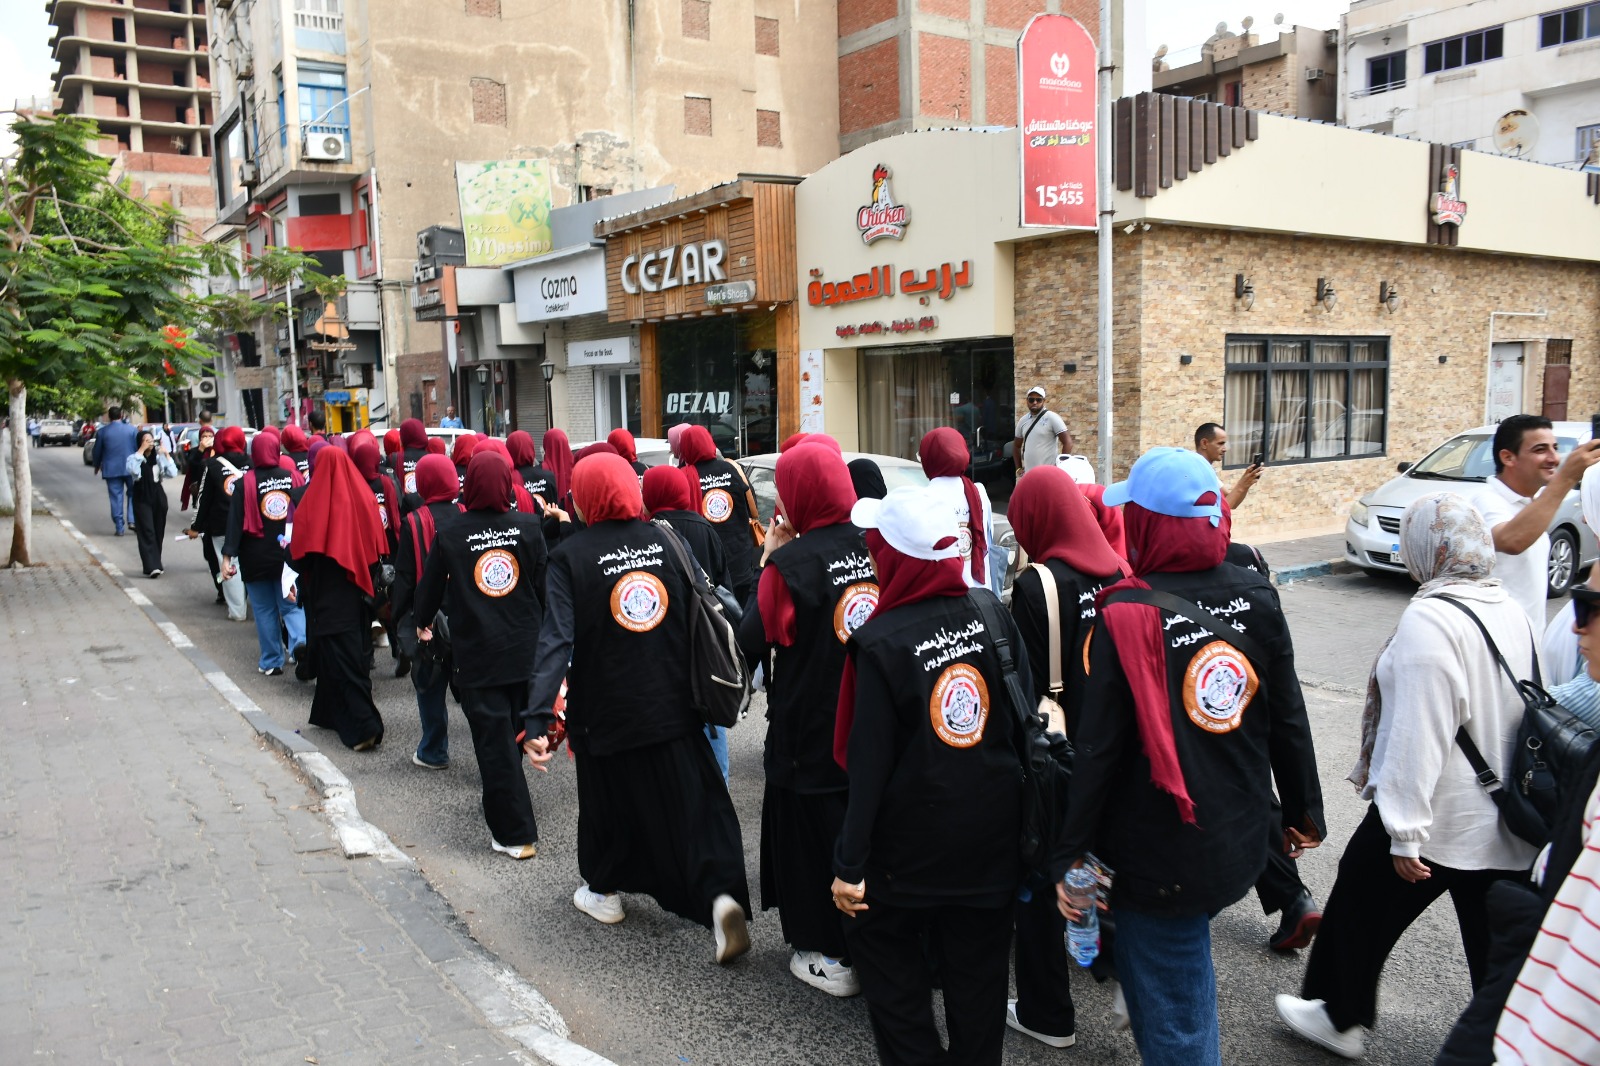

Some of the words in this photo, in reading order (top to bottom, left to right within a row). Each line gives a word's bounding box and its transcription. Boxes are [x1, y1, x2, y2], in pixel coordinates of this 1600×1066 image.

[1036, 185, 1084, 207] 15455
[859, 204, 905, 228] Chicken
[469, 222, 511, 235] Pizza
[470, 236, 551, 261] Massimo
[621, 239, 728, 295] CEZAR
[541, 275, 577, 300] Cozma
[808, 264, 893, 306] العمدة
[900, 260, 971, 306] درب
[728, 288, 748, 300] Shoes
[667, 391, 730, 414] CEZAR
[466, 533, 482, 543] مصر
[492, 530, 503, 539] من
[503, 527, 520, 538] طلاب
[616, 545, 630, 561] أجل
[630, 548, 642, 559] من
[642, 543, 664, 557] طلاب
[597, 553, 618, 565] مصر
[603, 559, 632, 576] السويس
[642, 556, 664, 567] جامعة
[827, 560, 846, 573] مصر
[845, 552, 857, 569] أجل
[832, 569, 858, 586] السويس
[1220, 597, 1251, 617] طلاب
[935, 626, 949, 648] أجل
[948, 631, 962, 645] من
[961, 619, 984, 641] طلاب
[914, 639, 937, 657] مصر
[961, 640, 984, 655] جامعة
[923, 649, 951, 672] السويس
